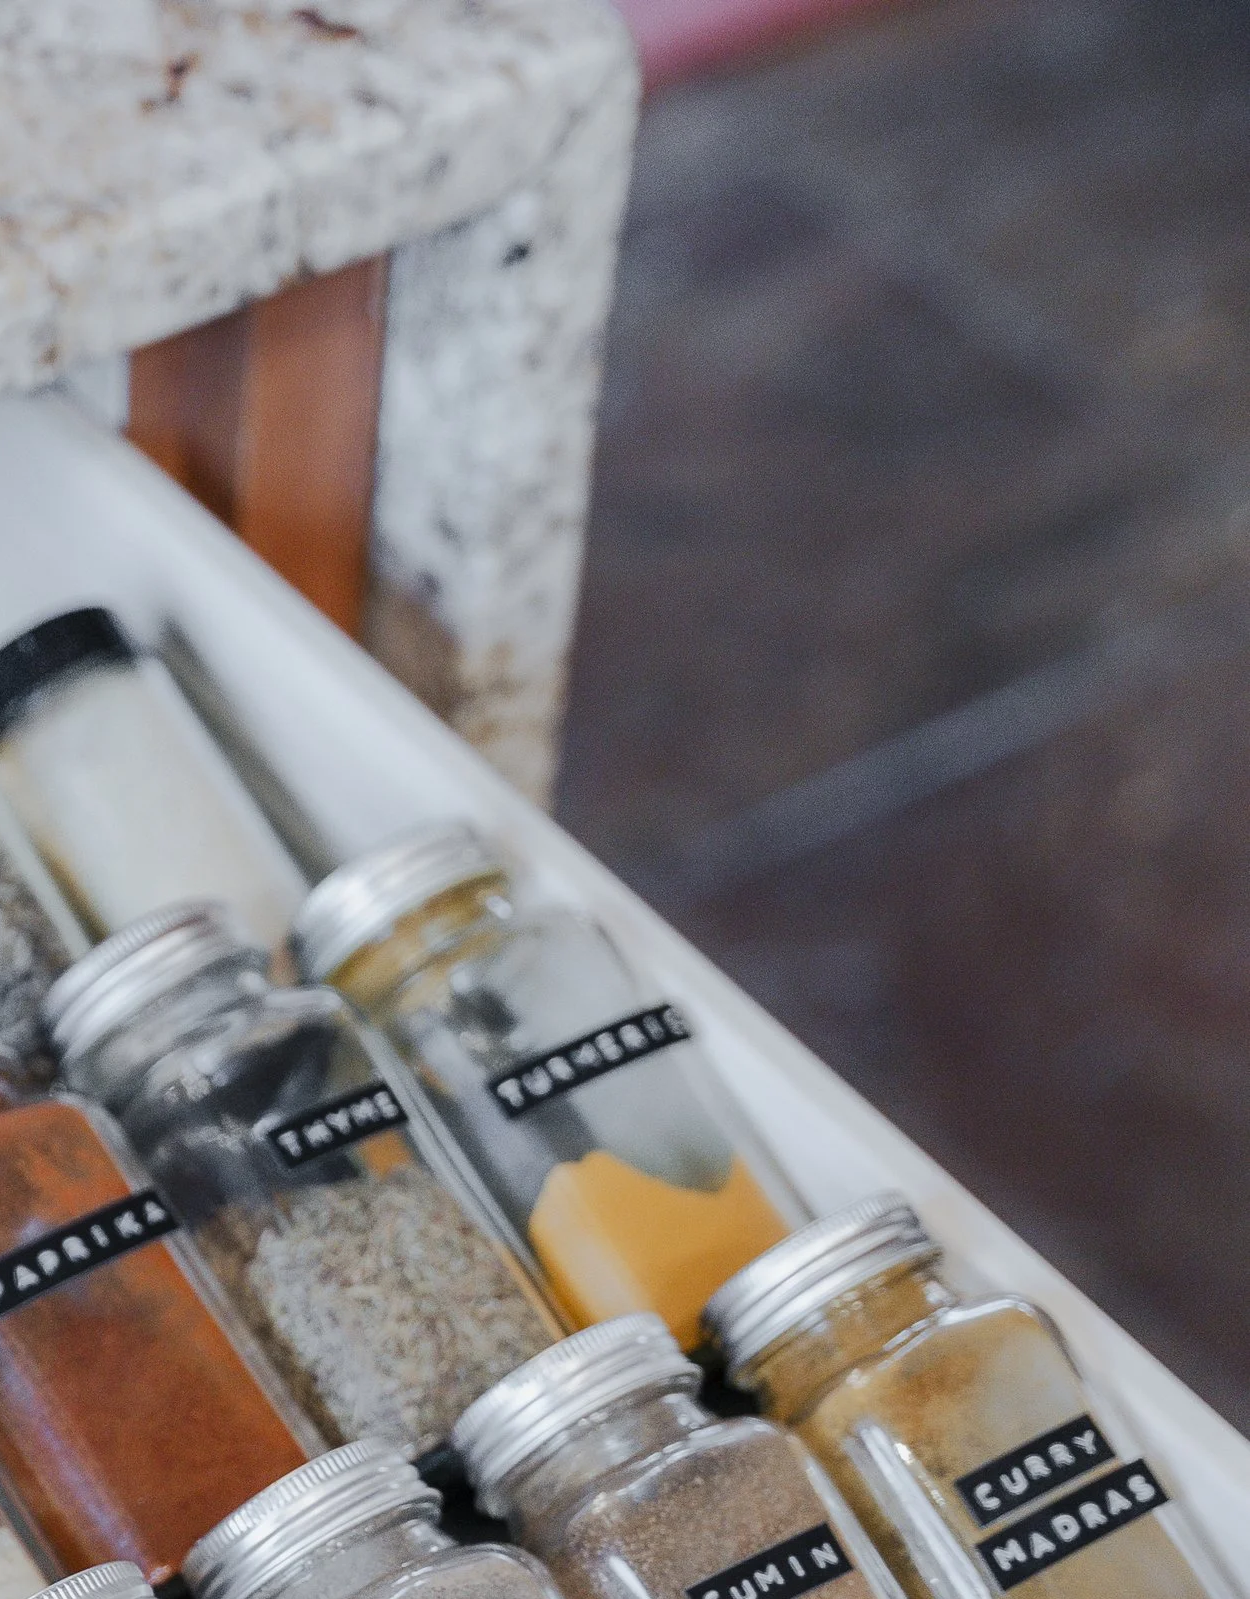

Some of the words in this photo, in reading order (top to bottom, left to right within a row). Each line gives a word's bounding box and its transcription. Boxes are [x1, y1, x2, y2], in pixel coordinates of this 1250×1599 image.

[277, 1090, 399, 1158] THYME
[973, 1428, 1098, 1511] CURRY
[992, 1473, 1156, 1572] MADRAS
